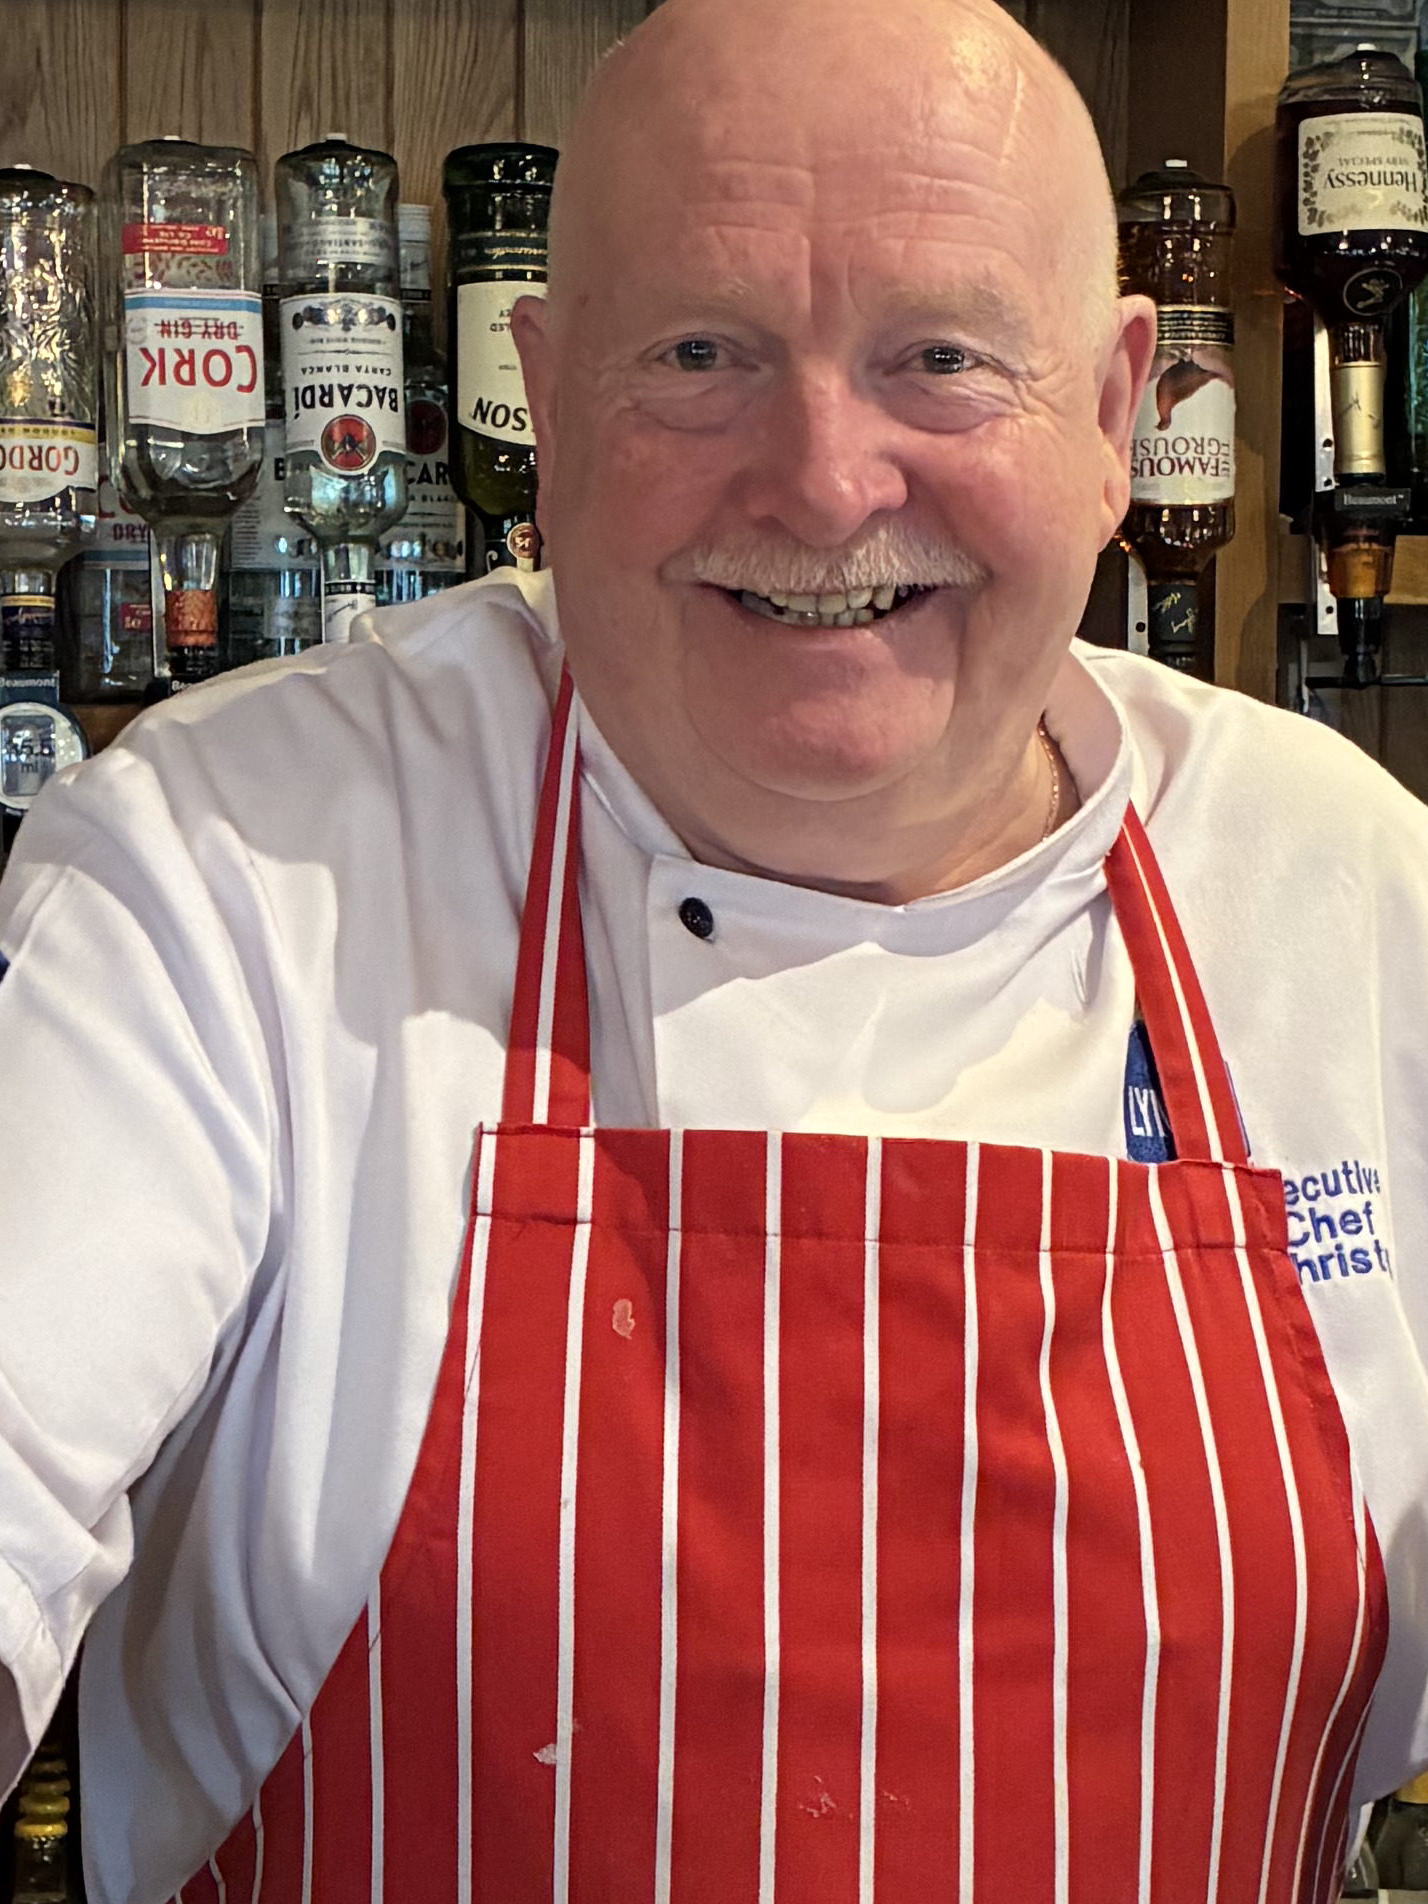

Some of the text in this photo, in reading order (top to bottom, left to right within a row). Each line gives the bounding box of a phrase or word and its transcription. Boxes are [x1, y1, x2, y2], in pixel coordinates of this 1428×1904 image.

[1326, 168, 1417, 193] Hennessy
[159, 318, 242, 341] DRY GIN
[139, 345, 258, 394] CORK
[299, 364, 393, 377] CARTA BLANCA
[1286, 1200, 1375, 1249] Chef
